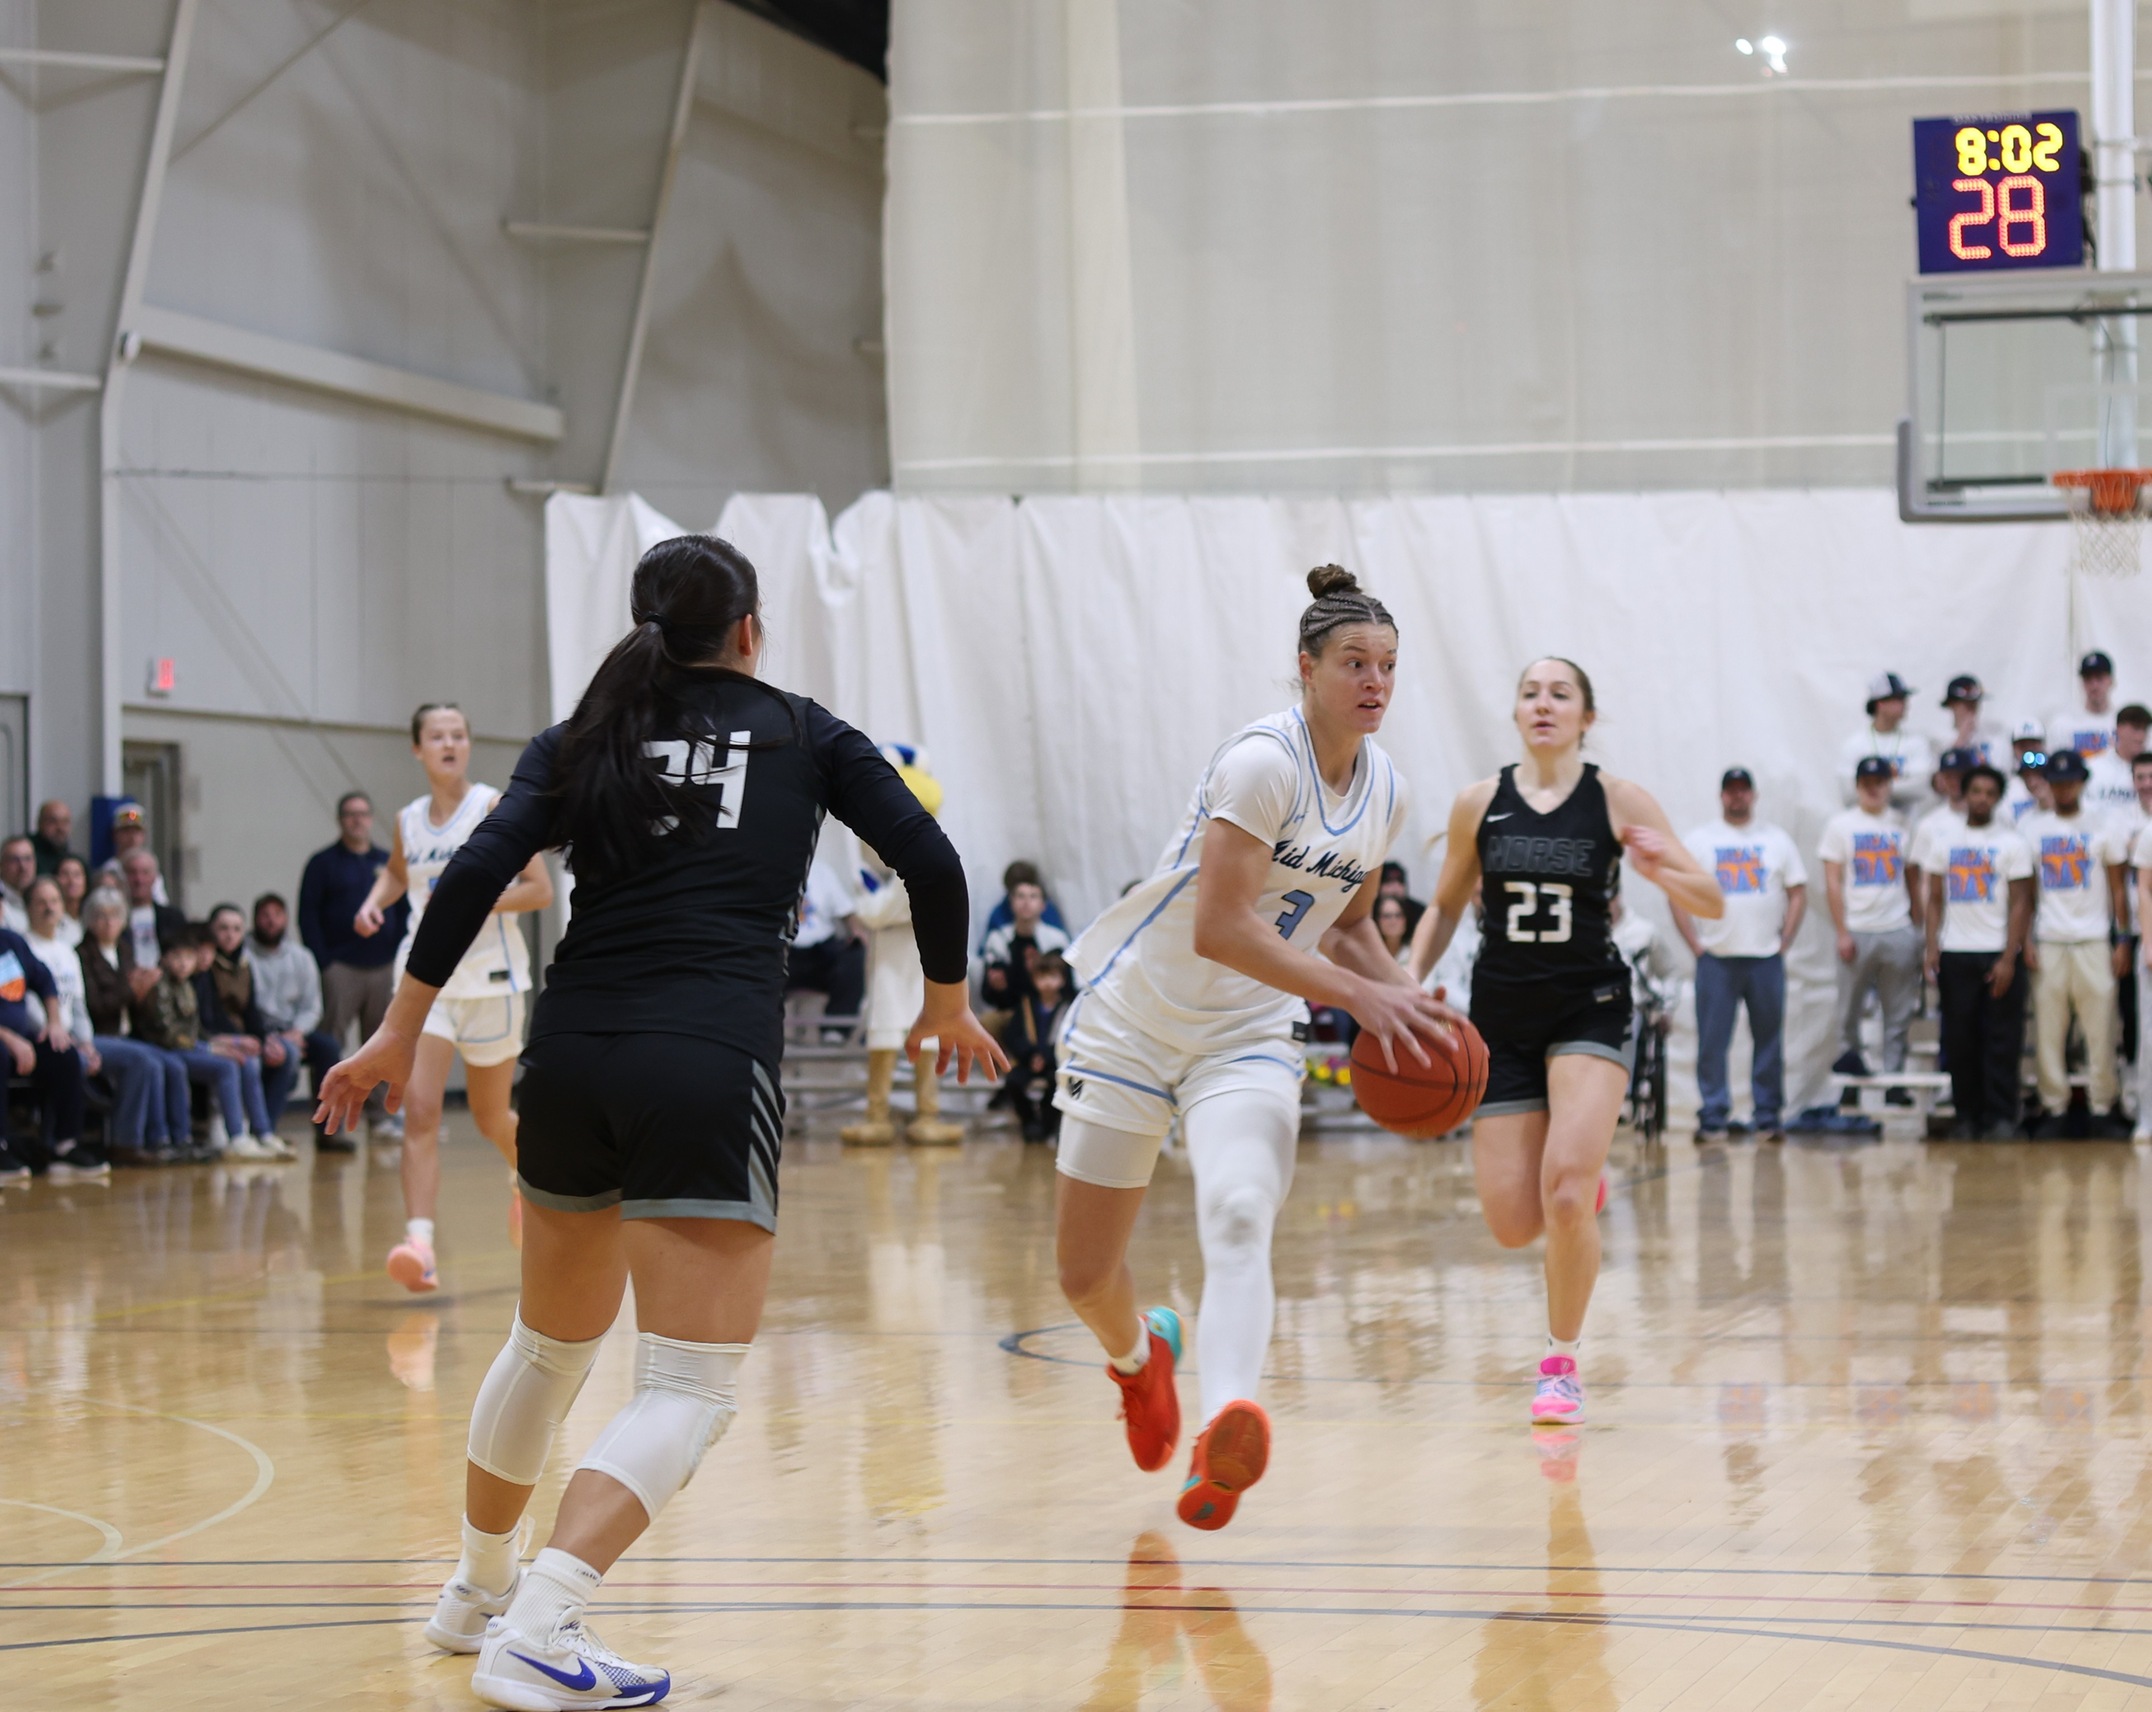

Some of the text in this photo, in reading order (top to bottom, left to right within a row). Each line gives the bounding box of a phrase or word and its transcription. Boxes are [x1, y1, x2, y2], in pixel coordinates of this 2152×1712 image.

[1955, 122, 2063, 176] 8:02
[1949, 175, 2046, 260] 28
[1486, 836, 1596, 877] NORSE
[1275, 889, 1316, 941] 3
[1503, 881, 1574, 943] 23
